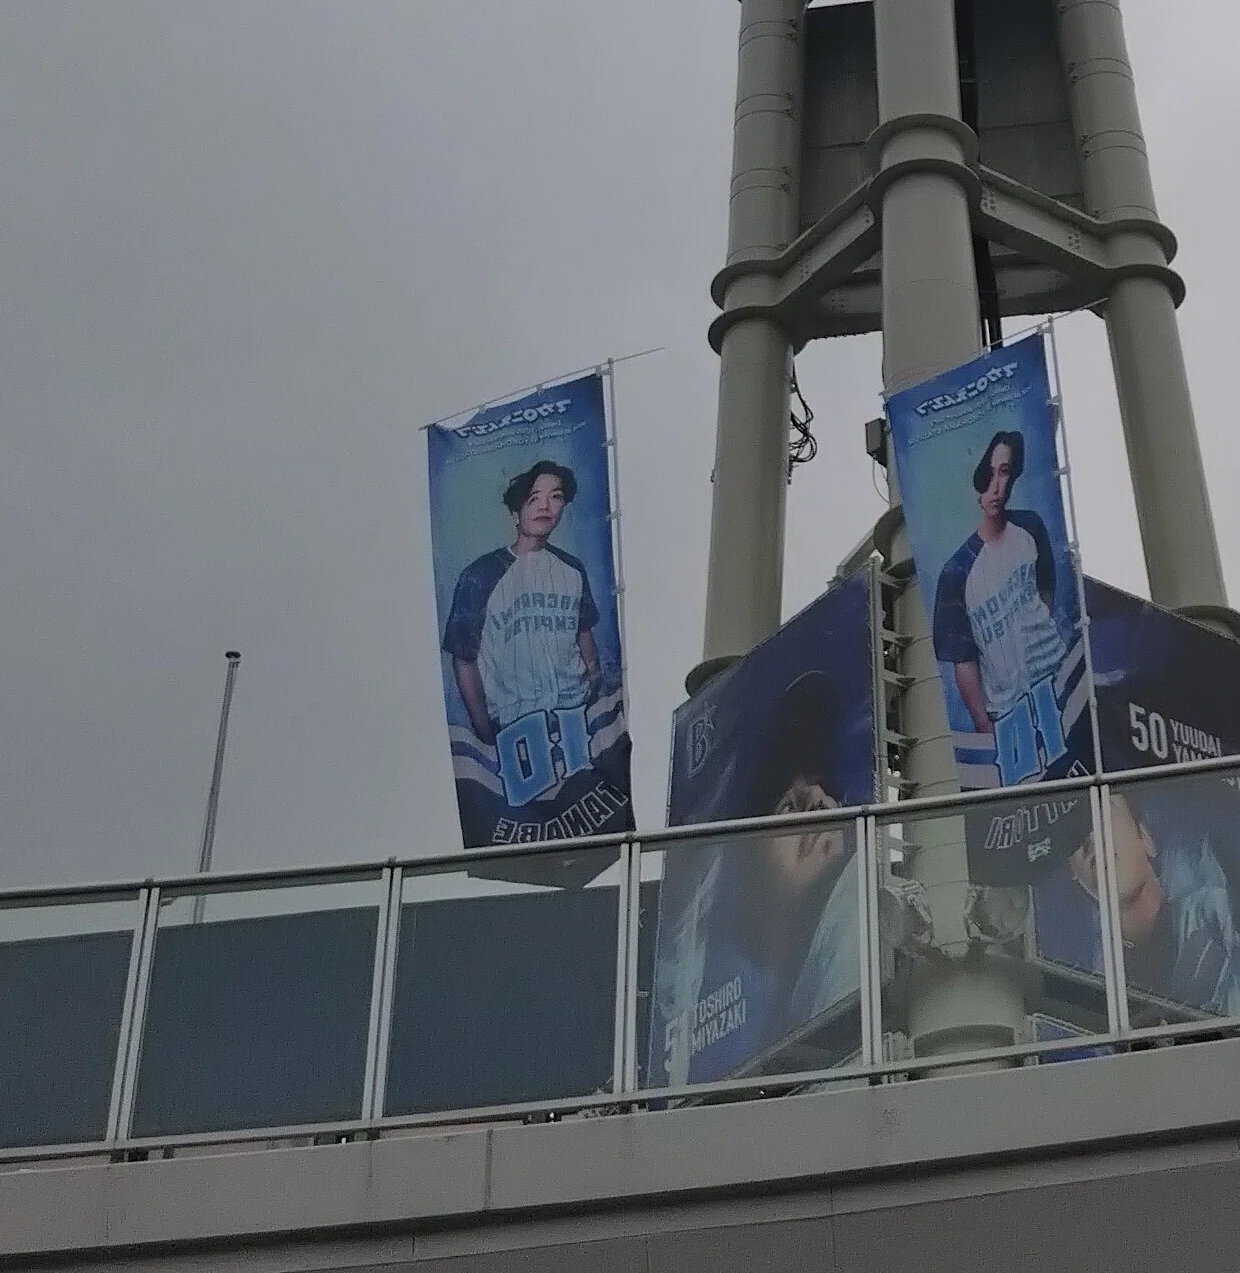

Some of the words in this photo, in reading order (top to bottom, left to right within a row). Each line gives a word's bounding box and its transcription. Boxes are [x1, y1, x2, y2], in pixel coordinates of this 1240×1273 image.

[1128, 701, 1169, 760] 50
[1169, 718, 1222, 758] YUUDAI
[691, 1000, 747, 1054] MIYAZAKI
